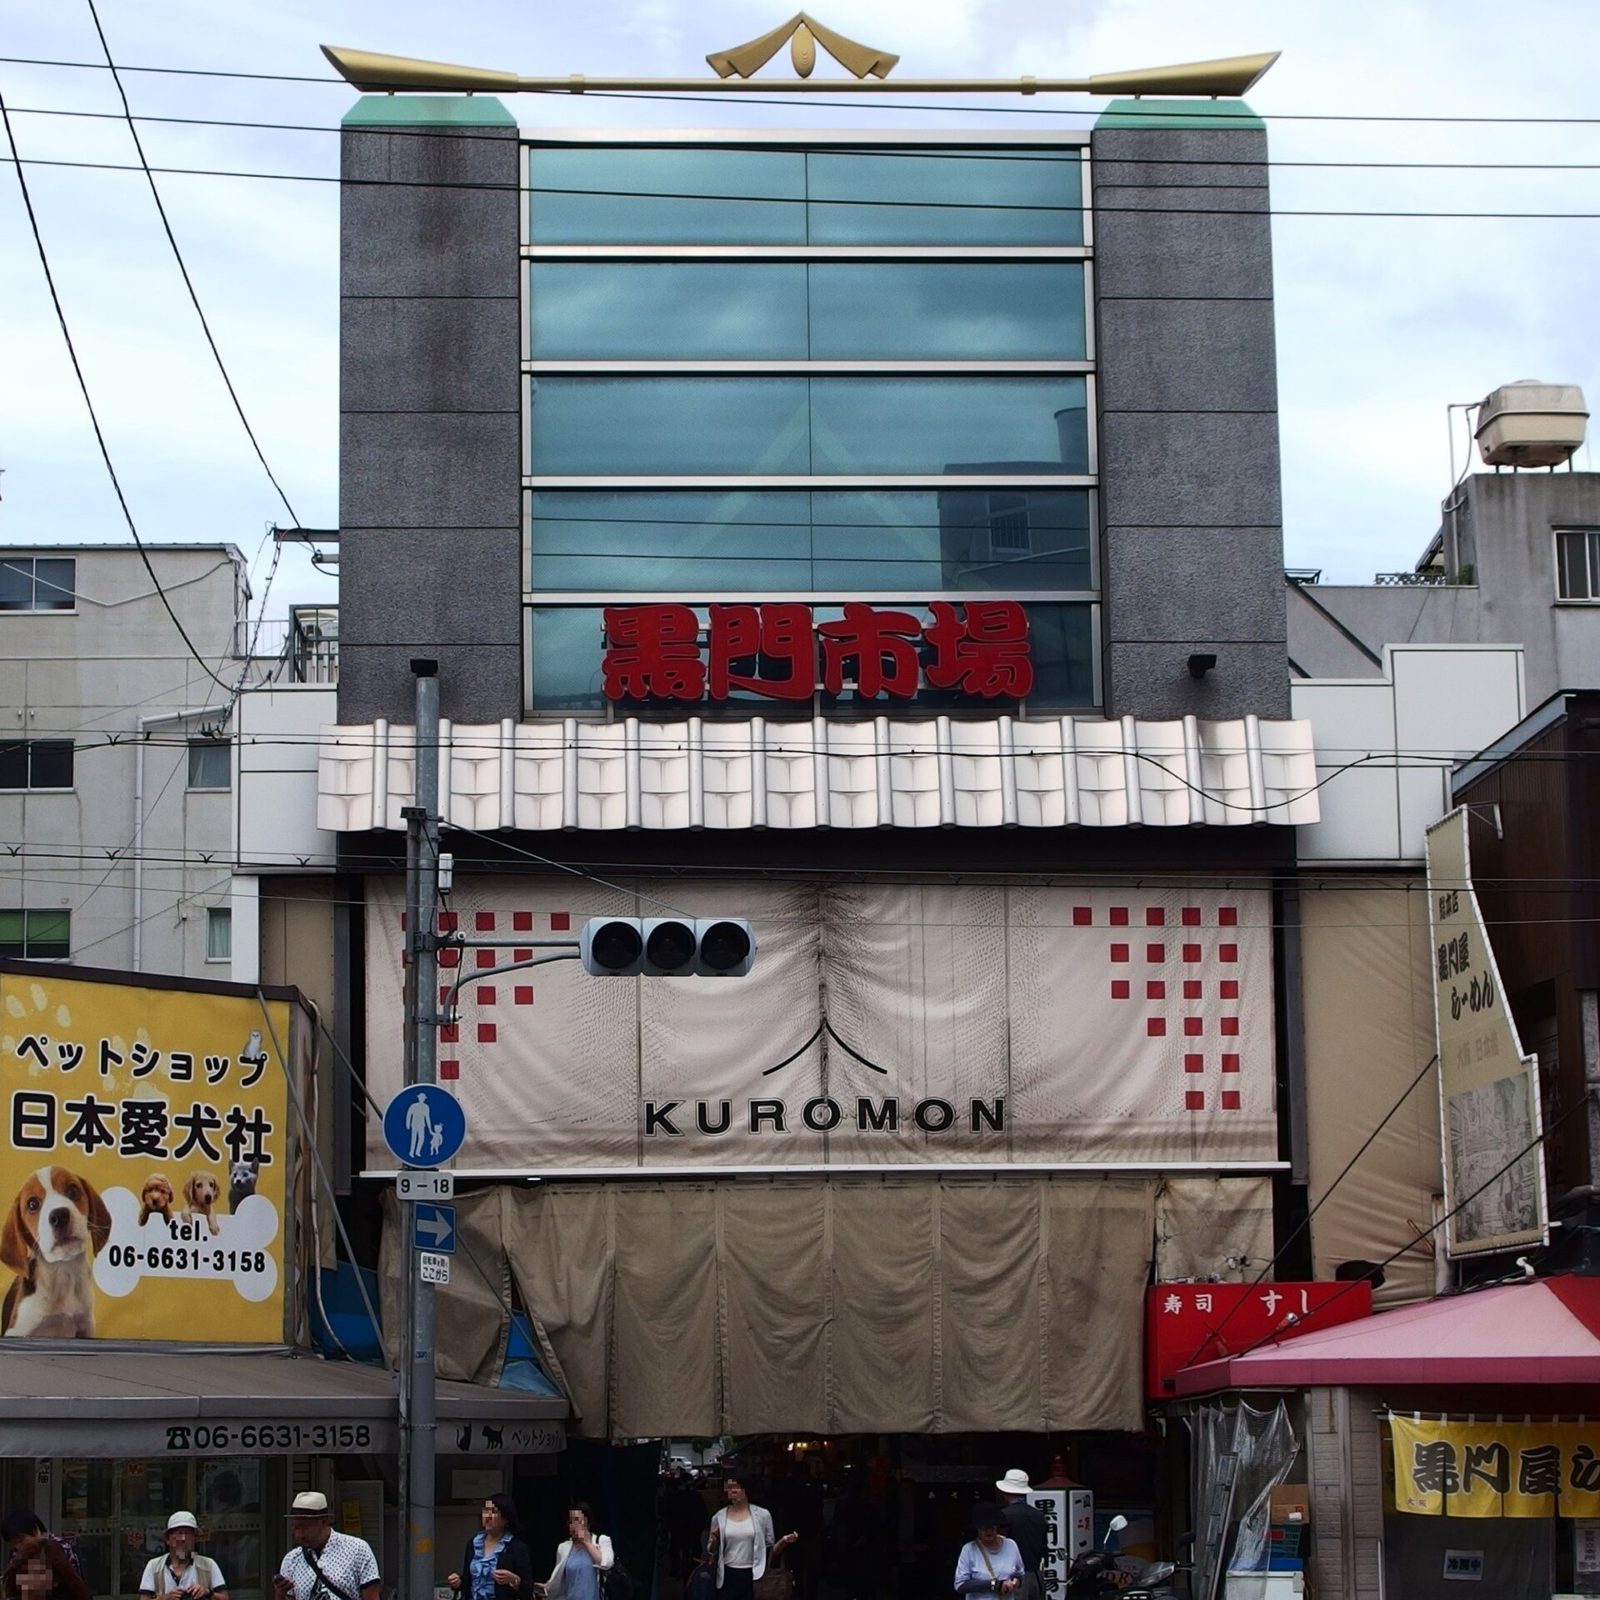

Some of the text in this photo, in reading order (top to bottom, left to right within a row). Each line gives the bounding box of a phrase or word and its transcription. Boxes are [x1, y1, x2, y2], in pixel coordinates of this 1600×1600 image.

[602, 601, 1034, 700] 黒門市場
[1451, 970, 1494, 1021] らーめん
[17, 1036, 268, 1086] ペットショップ
[10, 1092, 274, 1164] 日本愛犬社
[643, 1097, 1007, 1137] KUROMON
[170, 1221, 209, 1241] tel.
[108, 1245, 266, 1272] 06-6631-3158
[422, 1267, 448, 1282] ここから
[1163, 1289, 1310, 1317] 寿司 すし
[194, 1425, 371, 1449] 06-6631-3158
